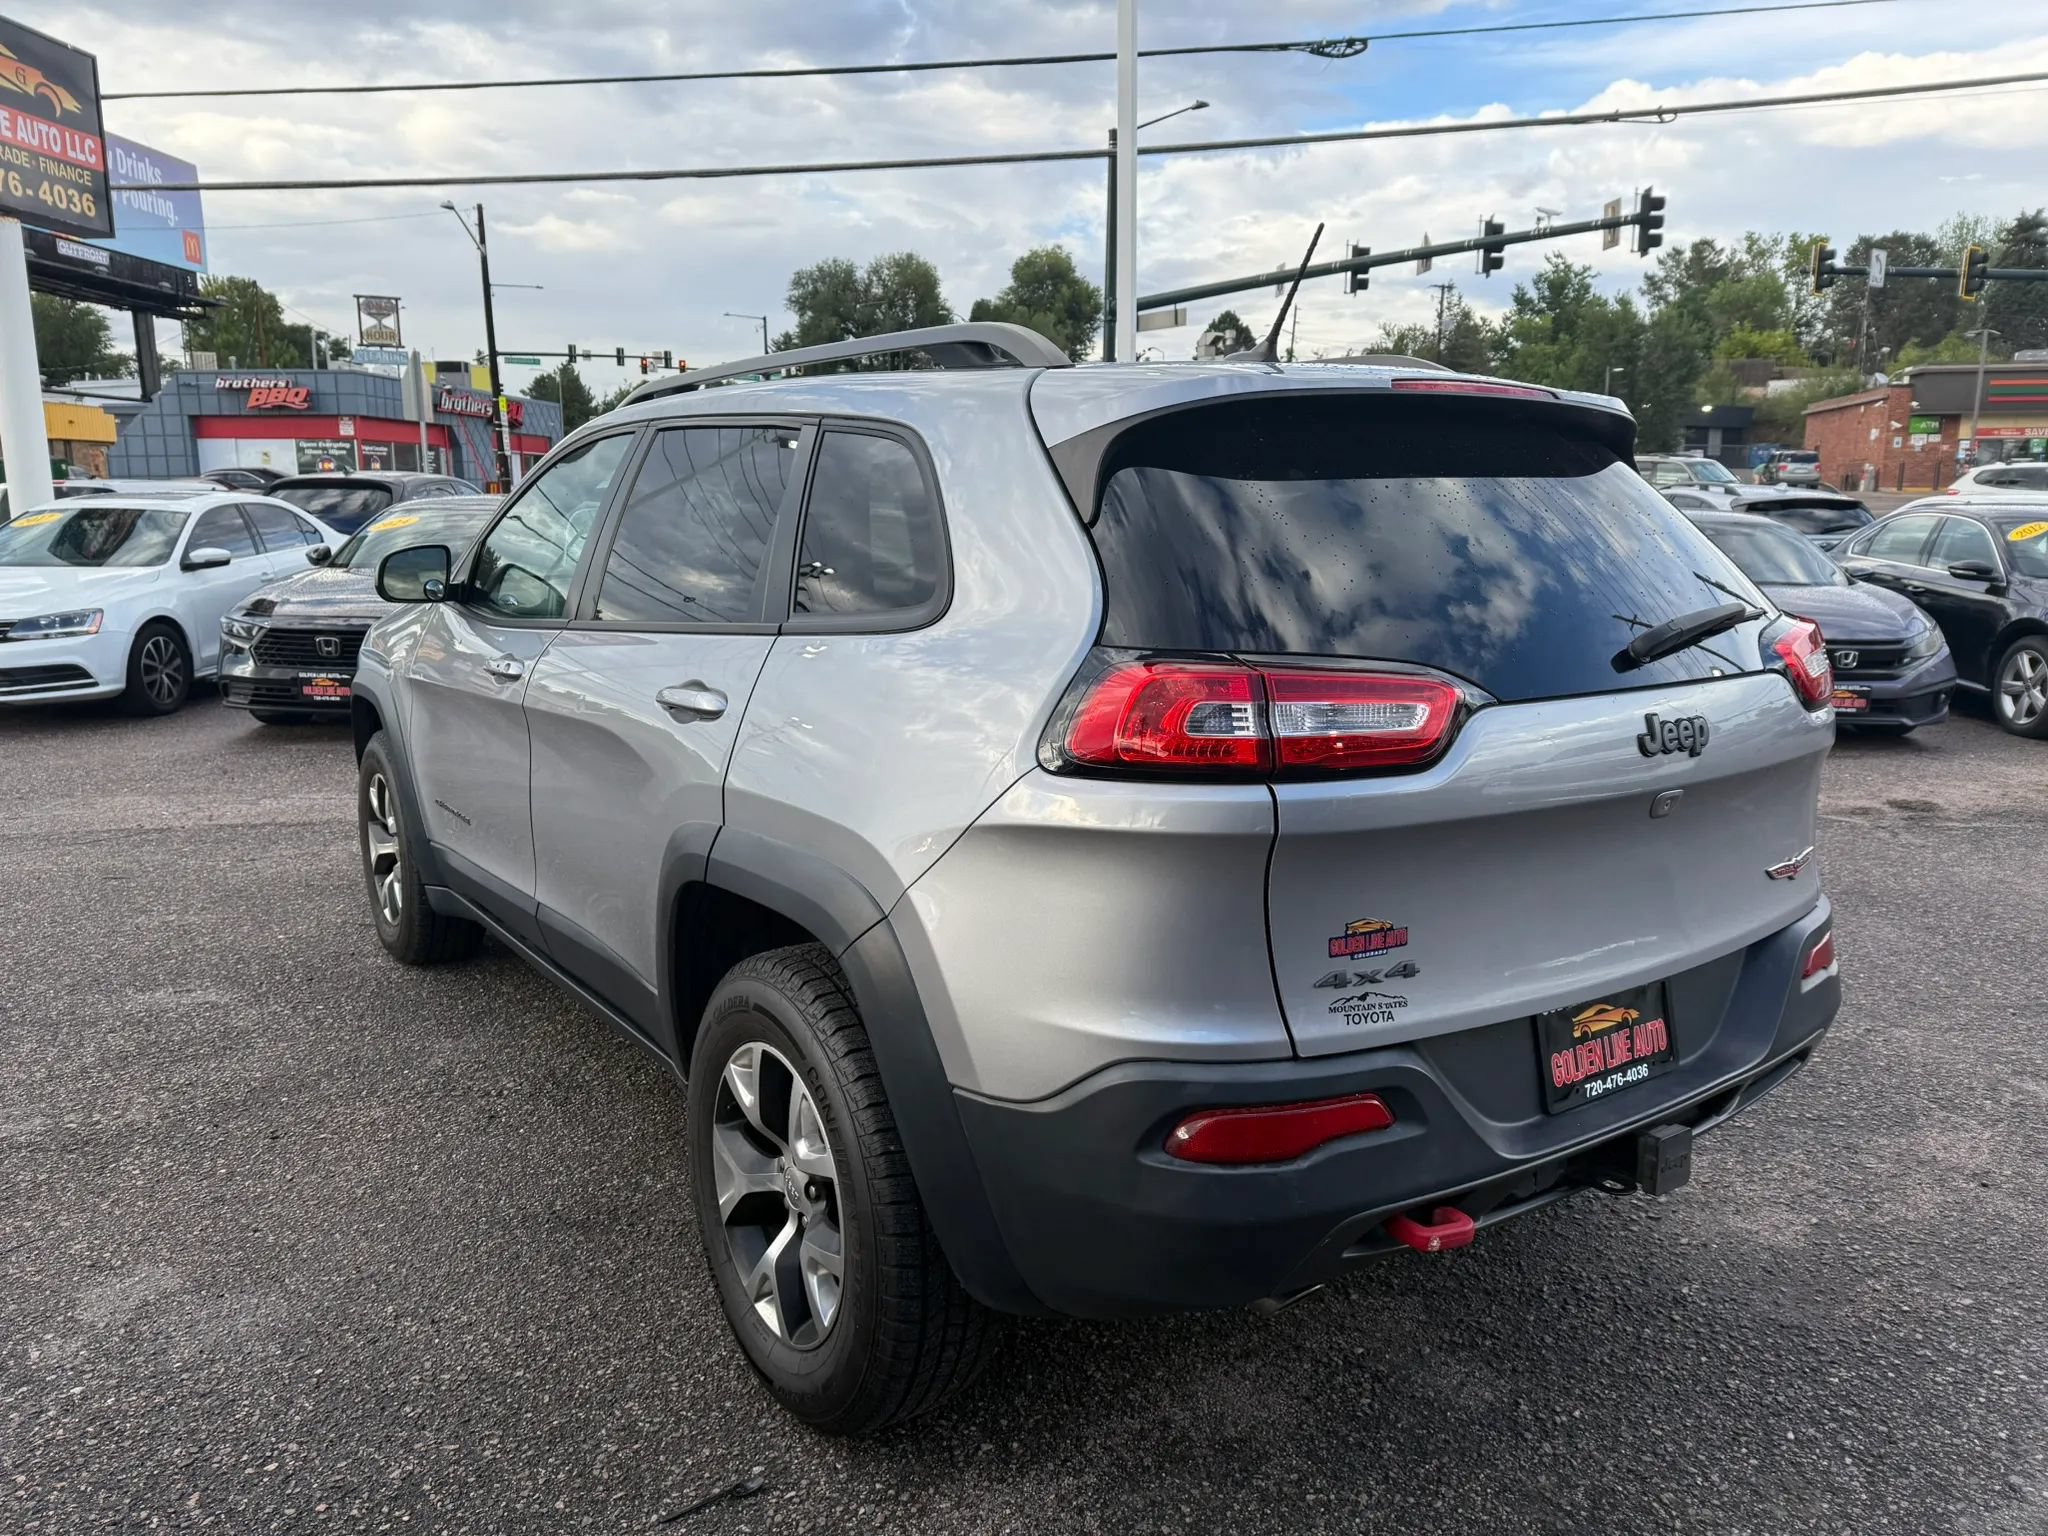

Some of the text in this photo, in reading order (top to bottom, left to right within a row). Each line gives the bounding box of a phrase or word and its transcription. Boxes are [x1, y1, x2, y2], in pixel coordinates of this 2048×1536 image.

[17, 115, 61, 153] AUTO
[65, 131, 97, 164] LLC
[39, 157, 92, 186] FINANCE
[115, 147, 162, 184] Drinks
[120, 180, 179, 227] Pouring.
[58, 241, 109, 264] OUTFRONT
[367, 330, 396, 341] HOUR
[215, 378, 287, 388] brothers
[247, 388, 309, 409] BBQ
[440, 391, 493, 416] brothers
[2015, 523, 2046, 538] 2012
[1637, 713, 1710, 757] Jeep
[1331, 928, 1408, 955] GOLDEN LINE AUTO
[1354, 949, 1387, 959] COLORADO
[1313, 960, 1420, 989] 4x4
[1328, 1000, 1408, 1013] MOUNTAIN STATES
[1344, 1010, 1395, 1026] TOYOTA
[1551, 1018, 1668, 1088] GOLDEN LINE AUTO
[1584, 1063, 1649, 1098] 720-476-4036
